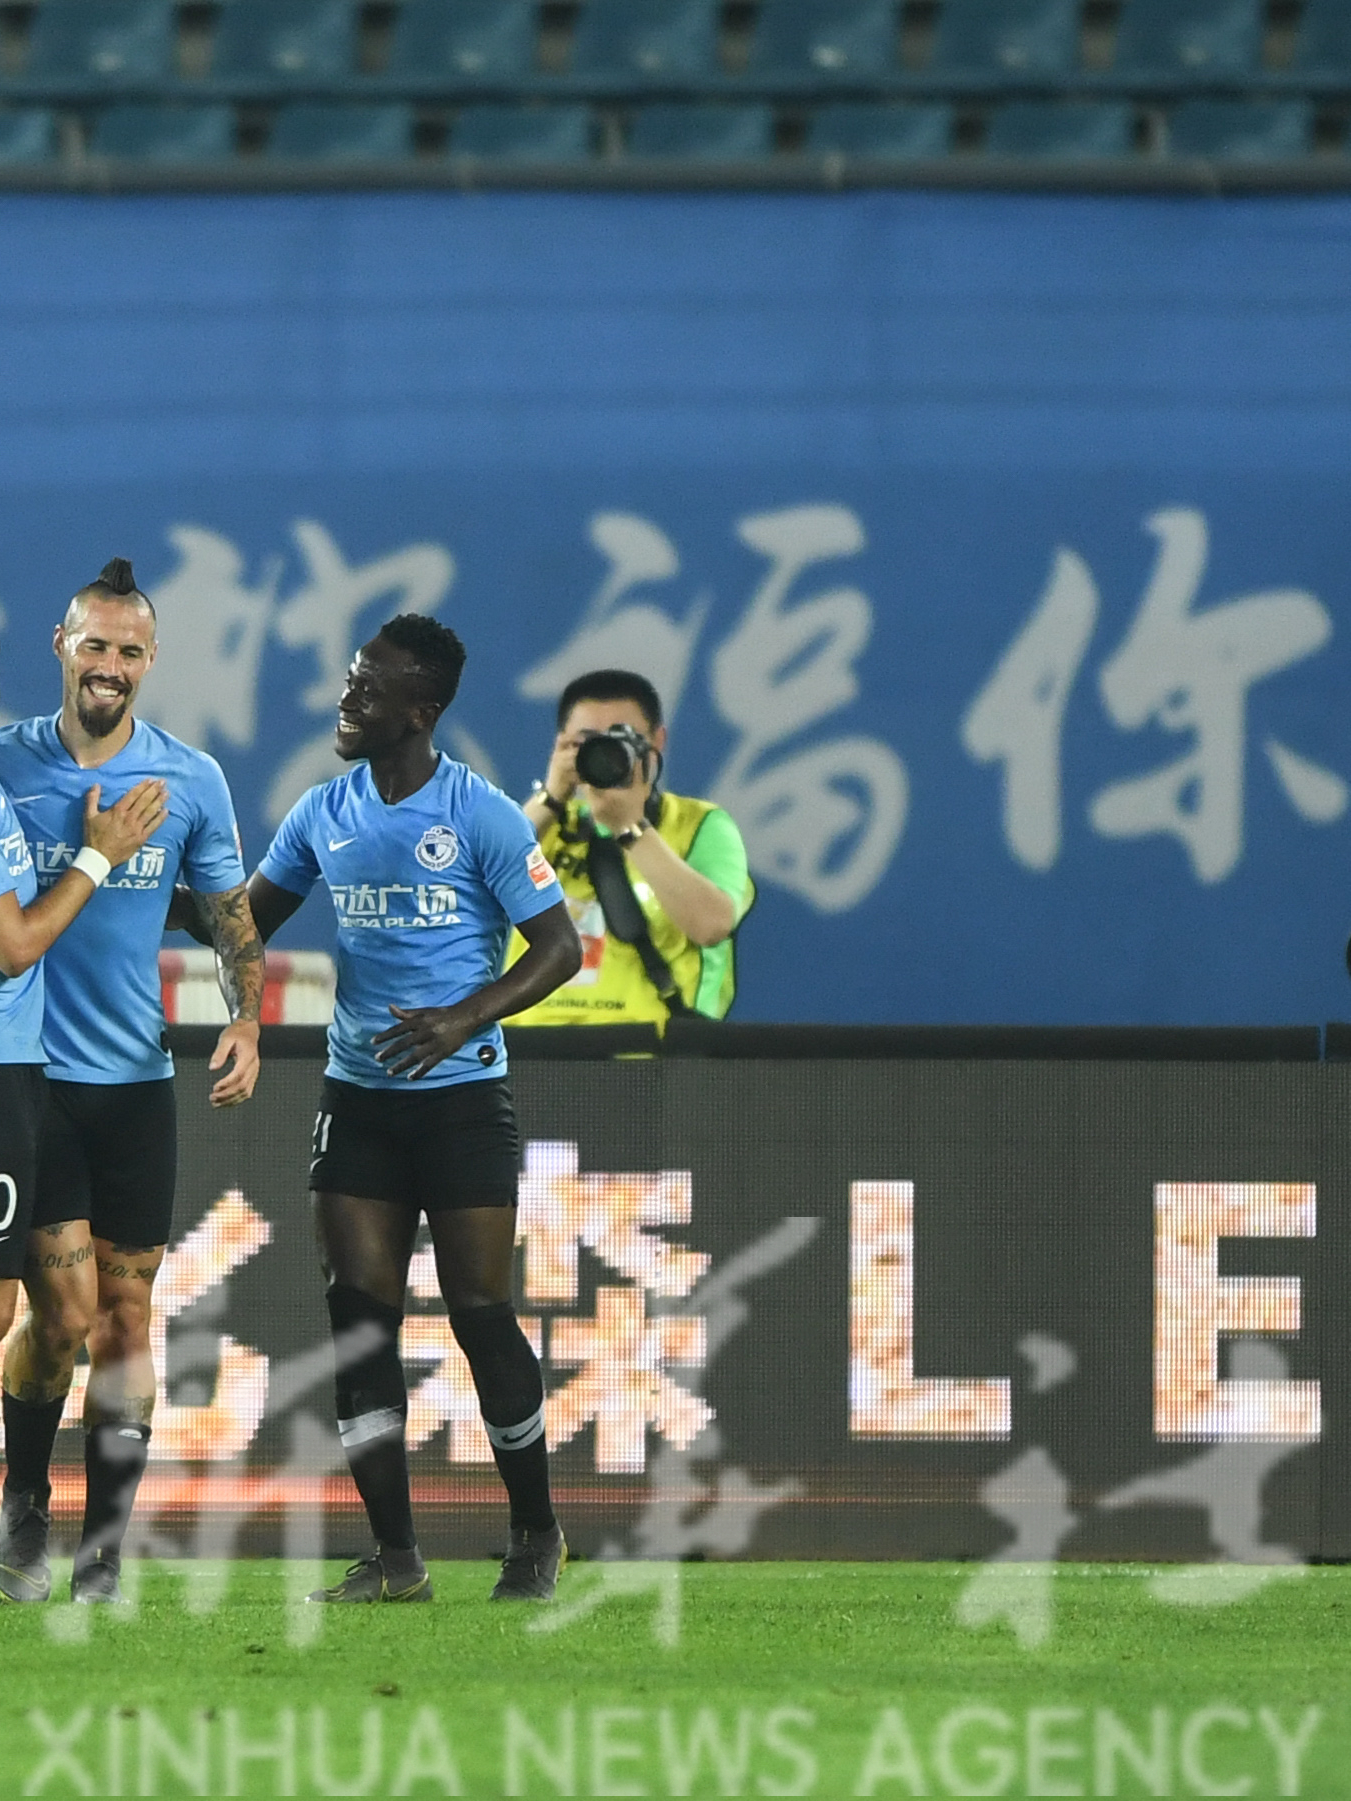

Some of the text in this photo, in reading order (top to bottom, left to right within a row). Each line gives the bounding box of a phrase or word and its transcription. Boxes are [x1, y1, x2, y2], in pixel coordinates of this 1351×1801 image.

[0, 831, 29, 861] 万
[102, 877, 160, 890] LAZA
[384, 914, 462, 929] PLAZA
